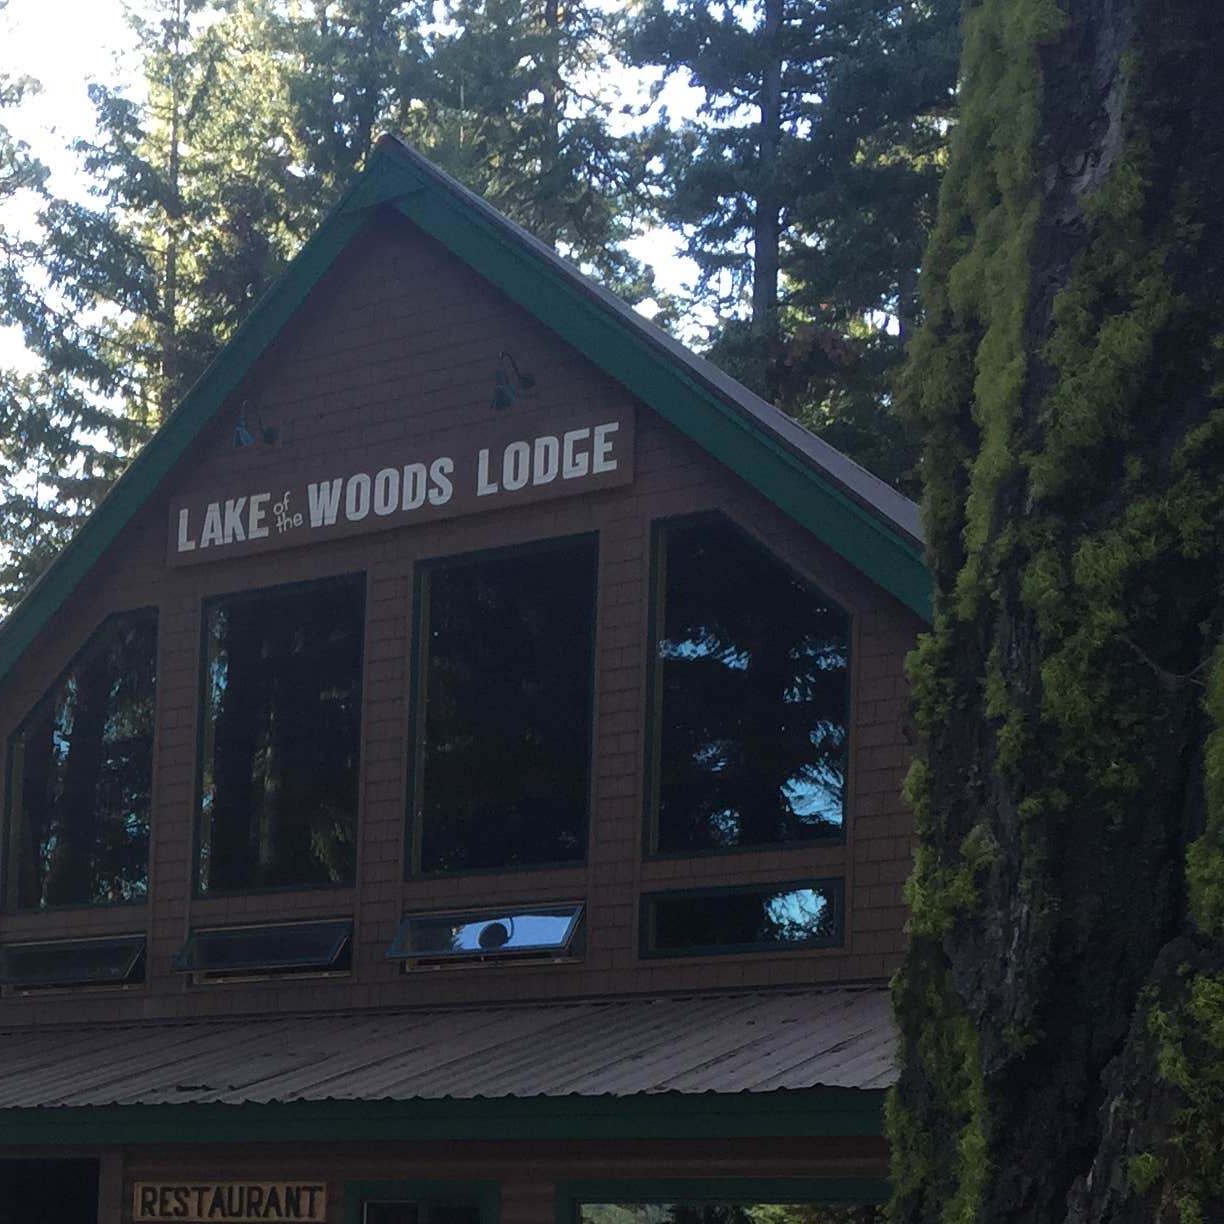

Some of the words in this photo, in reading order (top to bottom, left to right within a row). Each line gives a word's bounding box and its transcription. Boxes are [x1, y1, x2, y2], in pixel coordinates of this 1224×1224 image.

[476, 421, 620, 497] LODGE
[272, 490, 290, 516] of
[307, 456, 455, 528] WOODS
[177, 492, 271, 553] LAKE
[275, 511, 303, 534] the
[140, 1185, 323, 1219] RESTAURANT
